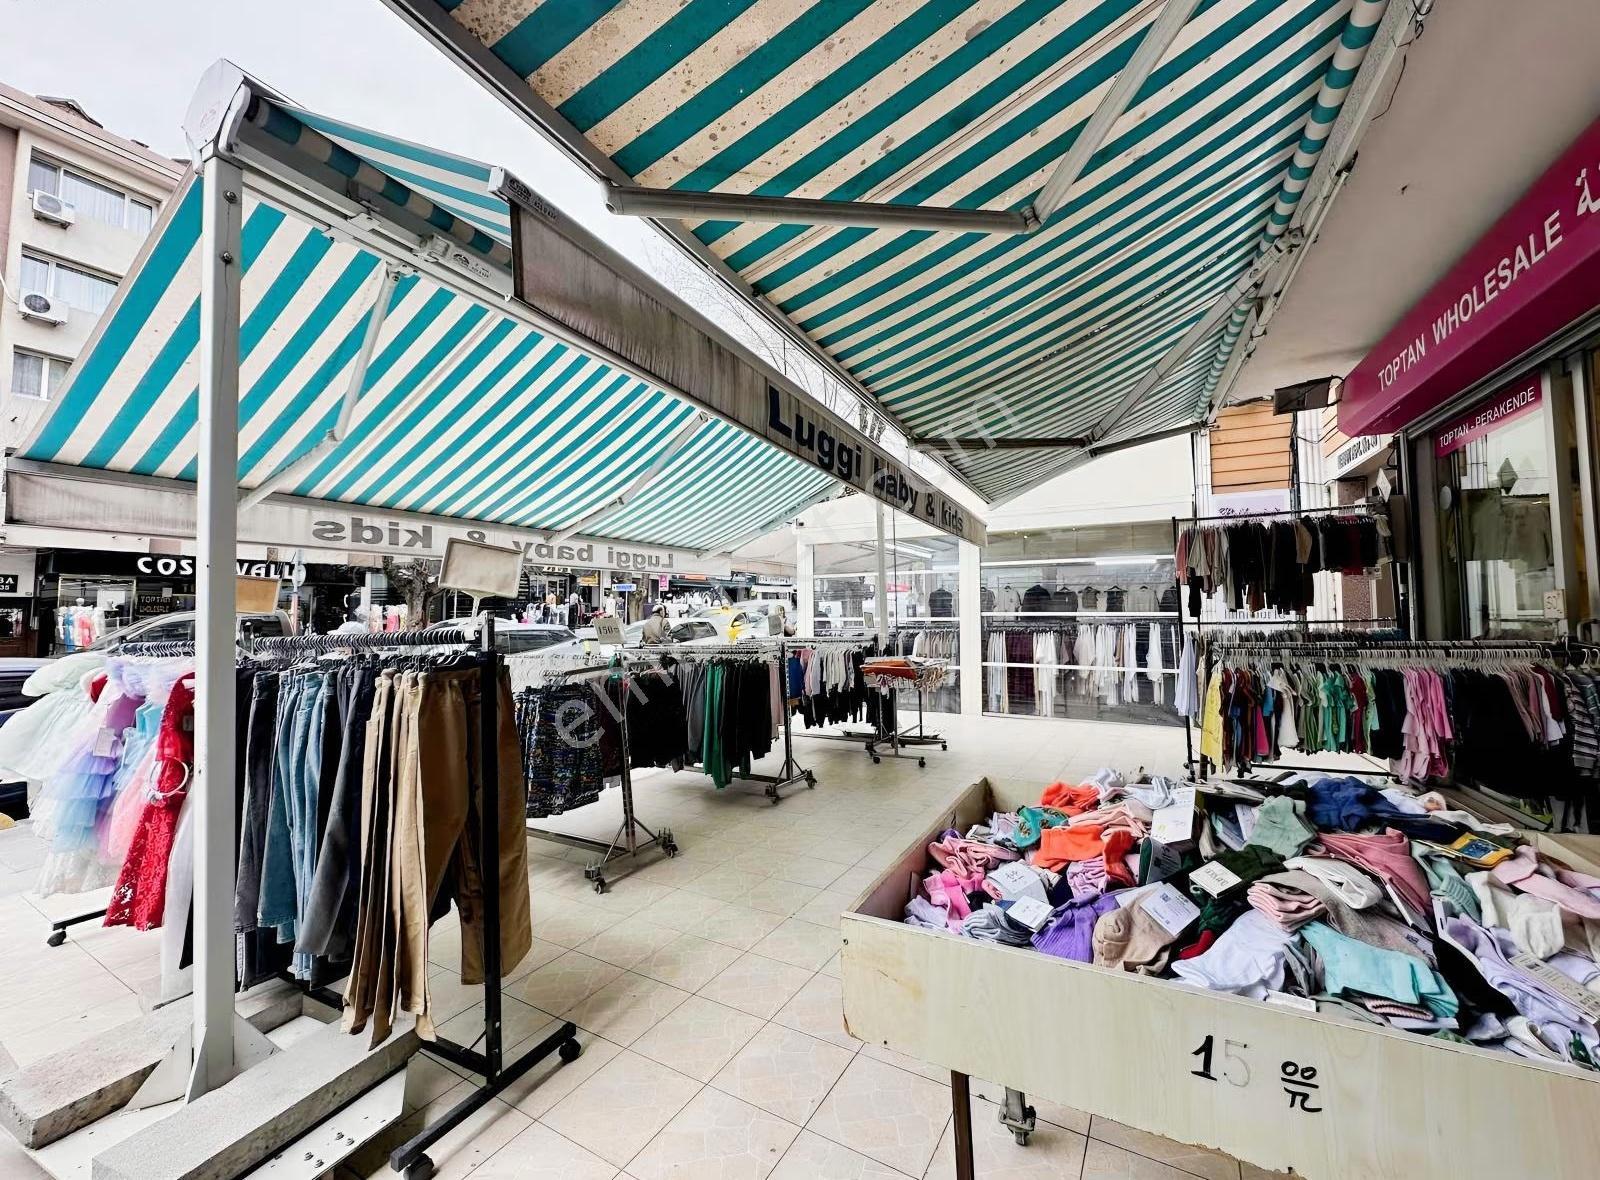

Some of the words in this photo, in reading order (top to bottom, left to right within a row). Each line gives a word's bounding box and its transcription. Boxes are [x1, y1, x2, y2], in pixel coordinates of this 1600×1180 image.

[1378, 333, 1427, 392] TOPTAN
[1432, 209, 1563, 346] WHOLESALE
[768, 384, 862, 482] Luggi
[873, 456, 918, 513] baby
[926, 493, 936, 517] &
[941, 504, 964, 533] kids
[1439, 421, 1469, 449] TOPTAN
[1475, 386, 1536, 432] PERAKENDE
